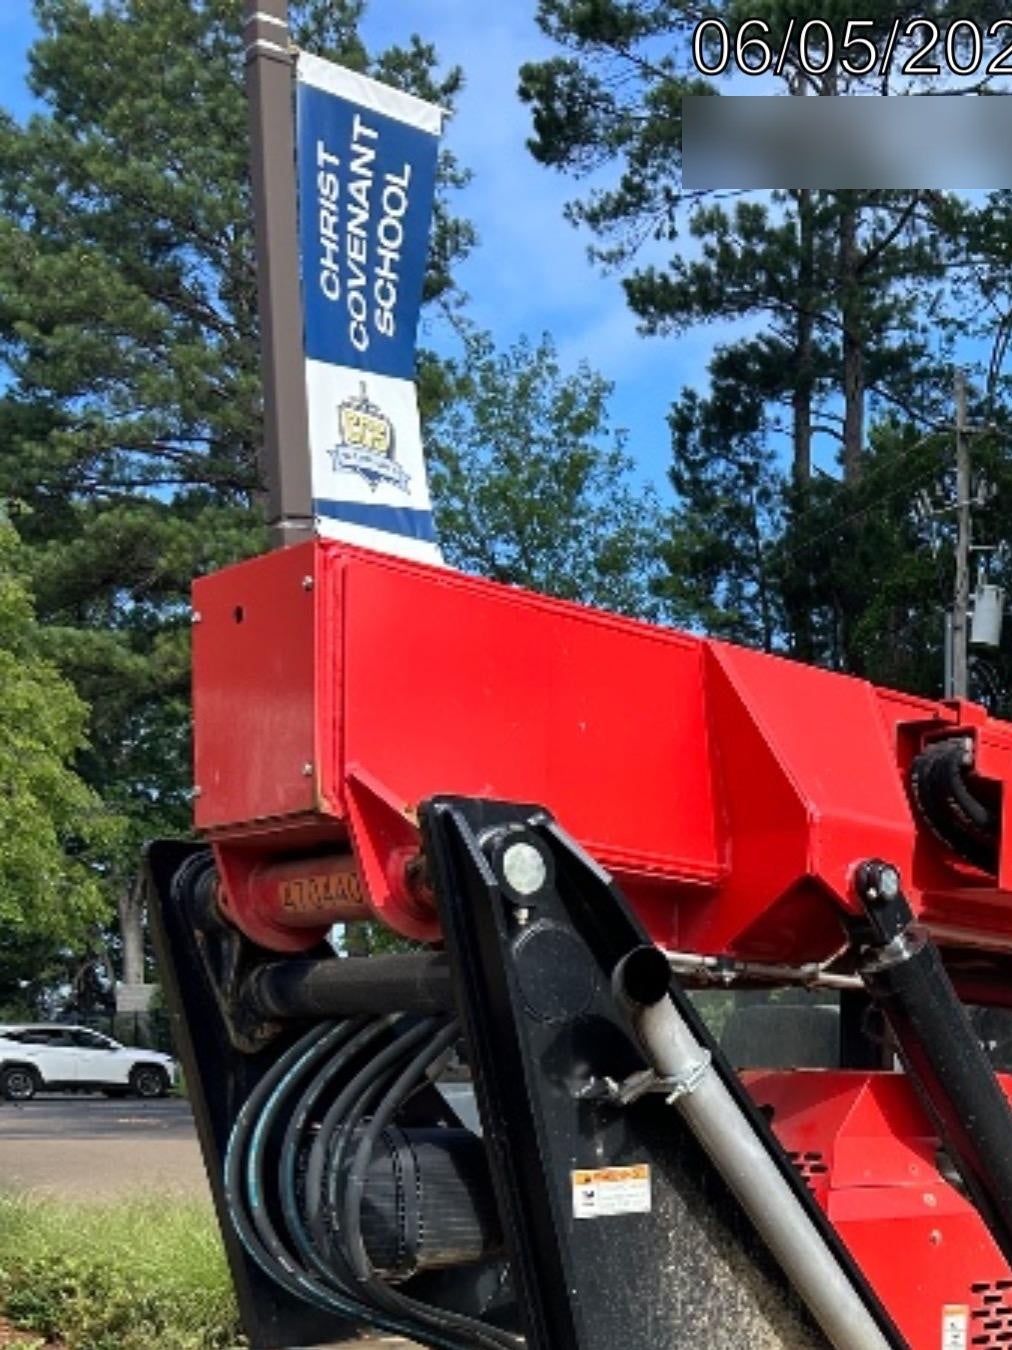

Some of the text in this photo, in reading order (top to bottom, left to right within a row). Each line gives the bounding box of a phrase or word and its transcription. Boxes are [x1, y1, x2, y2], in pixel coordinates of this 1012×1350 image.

[316, 139, 341, 301] CHRIST
[347, 113, 379, 352] COVENANT
[373, 163, 412, 338] SCHOOL
